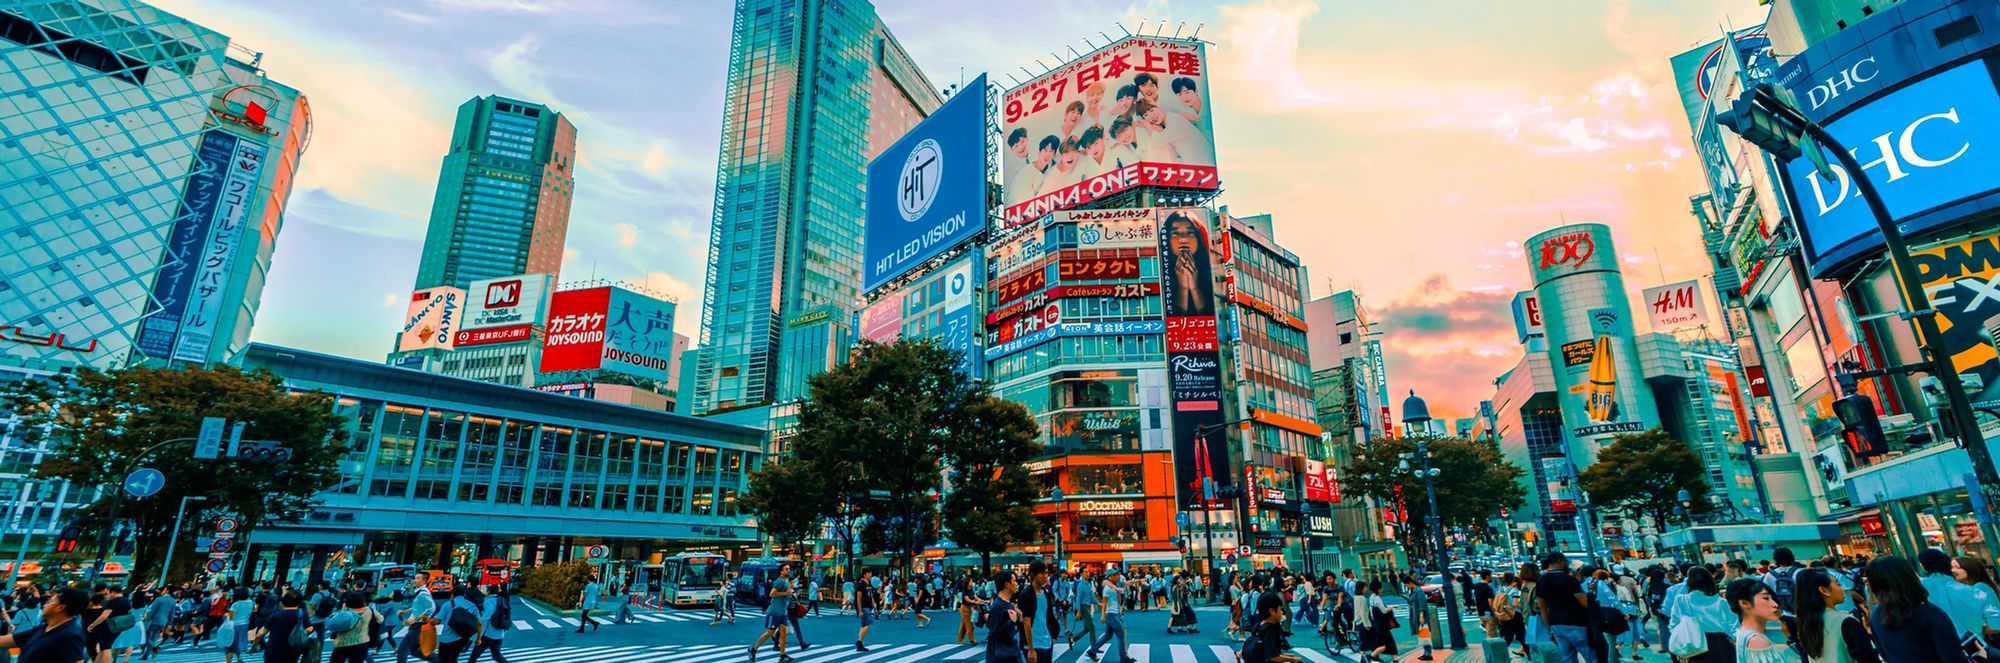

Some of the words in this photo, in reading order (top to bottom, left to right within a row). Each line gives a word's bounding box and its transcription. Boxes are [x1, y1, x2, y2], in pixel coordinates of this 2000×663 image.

[1005, 77, 1068, 124] 9.27
[1076, 48, 1200, 94] 日本上陸
[1806, 56, 1879, 111] DHC
[1806, 106, 1970, 217] DHC
[1142, 165, 1215, 185] ワナワン
[1068, 208, 1150, 220] しゃぶしゃぶバイキング
[1104, 224, 1153, 241] しゃぶ葉
[876, 252, 895, 276] HIT
[896, 236, 920, 266] LED
[922, 210, 966, 245] VISION
[186, 180, 246, 327] ワコールビッグバザール
[1539, 238, 1594, 270] 109
[1060, 260, 1136, 276] コンタクト
[487, 283, 518, 305] DC
[1114, 284, 1151, 298] ガスト
[1653, 285, 1694, 314] H&M
[1024, 293, 1049, 312] ガスト
[404, 294, 443, 333] SANKYO
[438, 292, 458, 343] SANKYO
[550, 312, 605, 333] カラオケ
[610, 300, 672, 335] 大声
[1168, 317, 1215, 330] ユリゴコロ
[1662, 315, 1688, 327] 150m
[989, 329, 999, 343] 7F
[1014, 315, 1043, 339] ガスト
[1094, 322, 1163, 333] 英会話イーオン
[547, 331, 603, 346] JOYSOUND
[604, 347, 667, 371] JOYSOUND
[1175, 373, 1193, 382] 9.20
[1079, 500, 1134, 511] L'OCCITANE
[1310, 515, 1333, 531] LUSH
